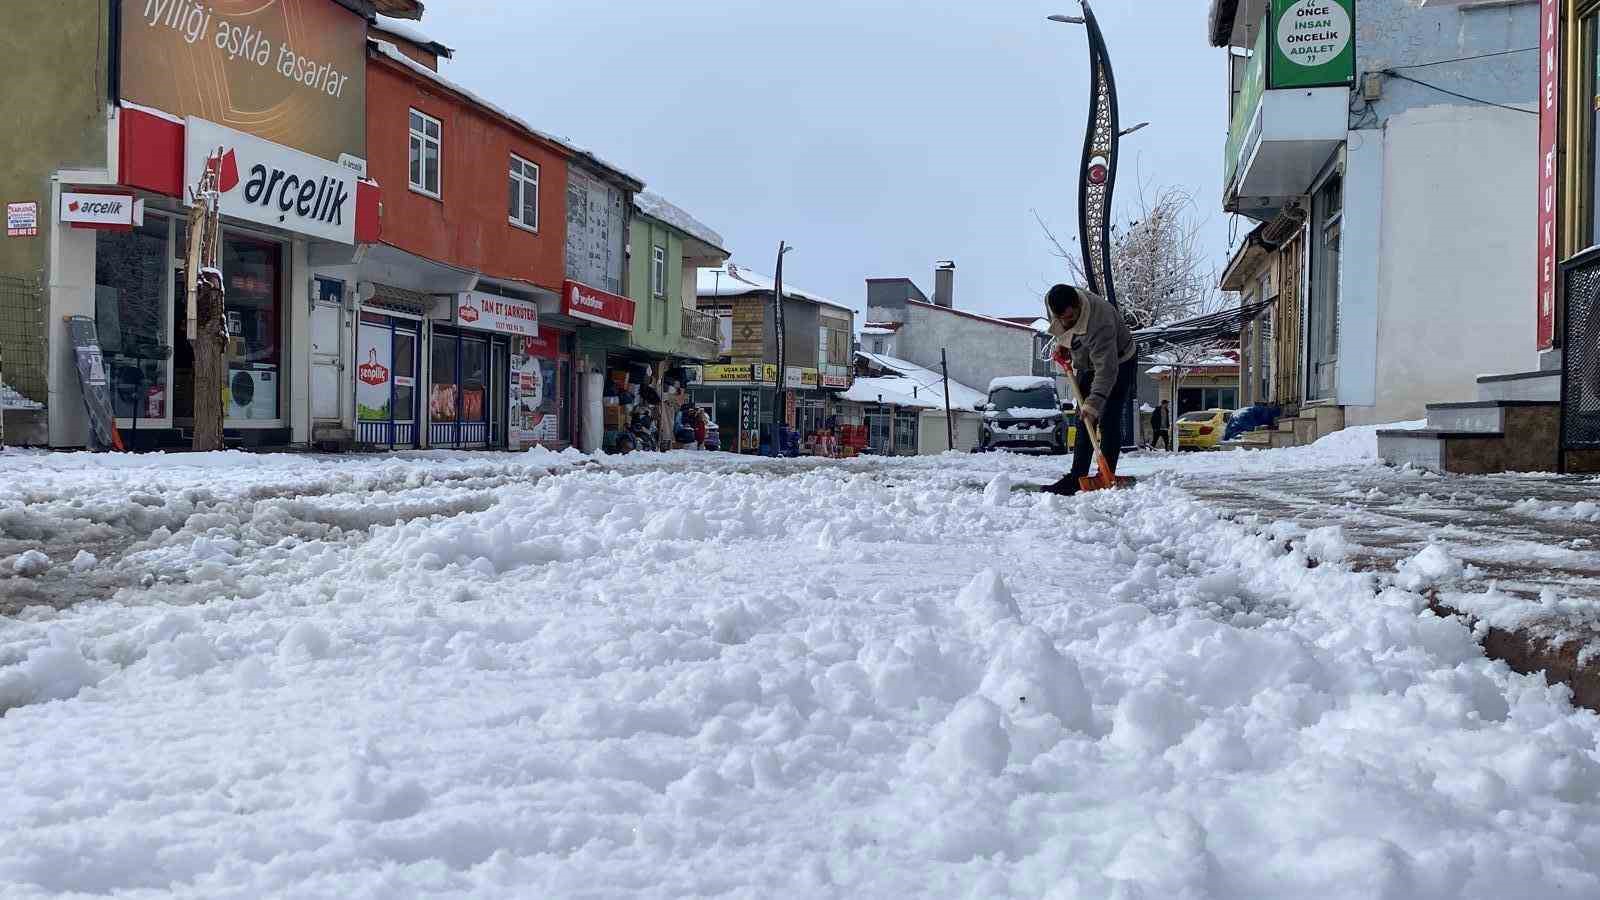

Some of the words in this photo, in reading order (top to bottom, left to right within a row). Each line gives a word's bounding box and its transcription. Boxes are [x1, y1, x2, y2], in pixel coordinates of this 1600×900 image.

[1296, 6, 1329, 17] ÖNCE
[1294, 19, 1332, 30] İNSAN
[1286, 30, 1339, 43] ÖNCELİK
[1290, 44, 1337, 55] ADALET
[215, 21, 271, 66] aşkla
[276, 41, 349, 98] tasarlar
[244, 163, 349, 226] arçelik
[80, 201, 123, 216] arçelik
